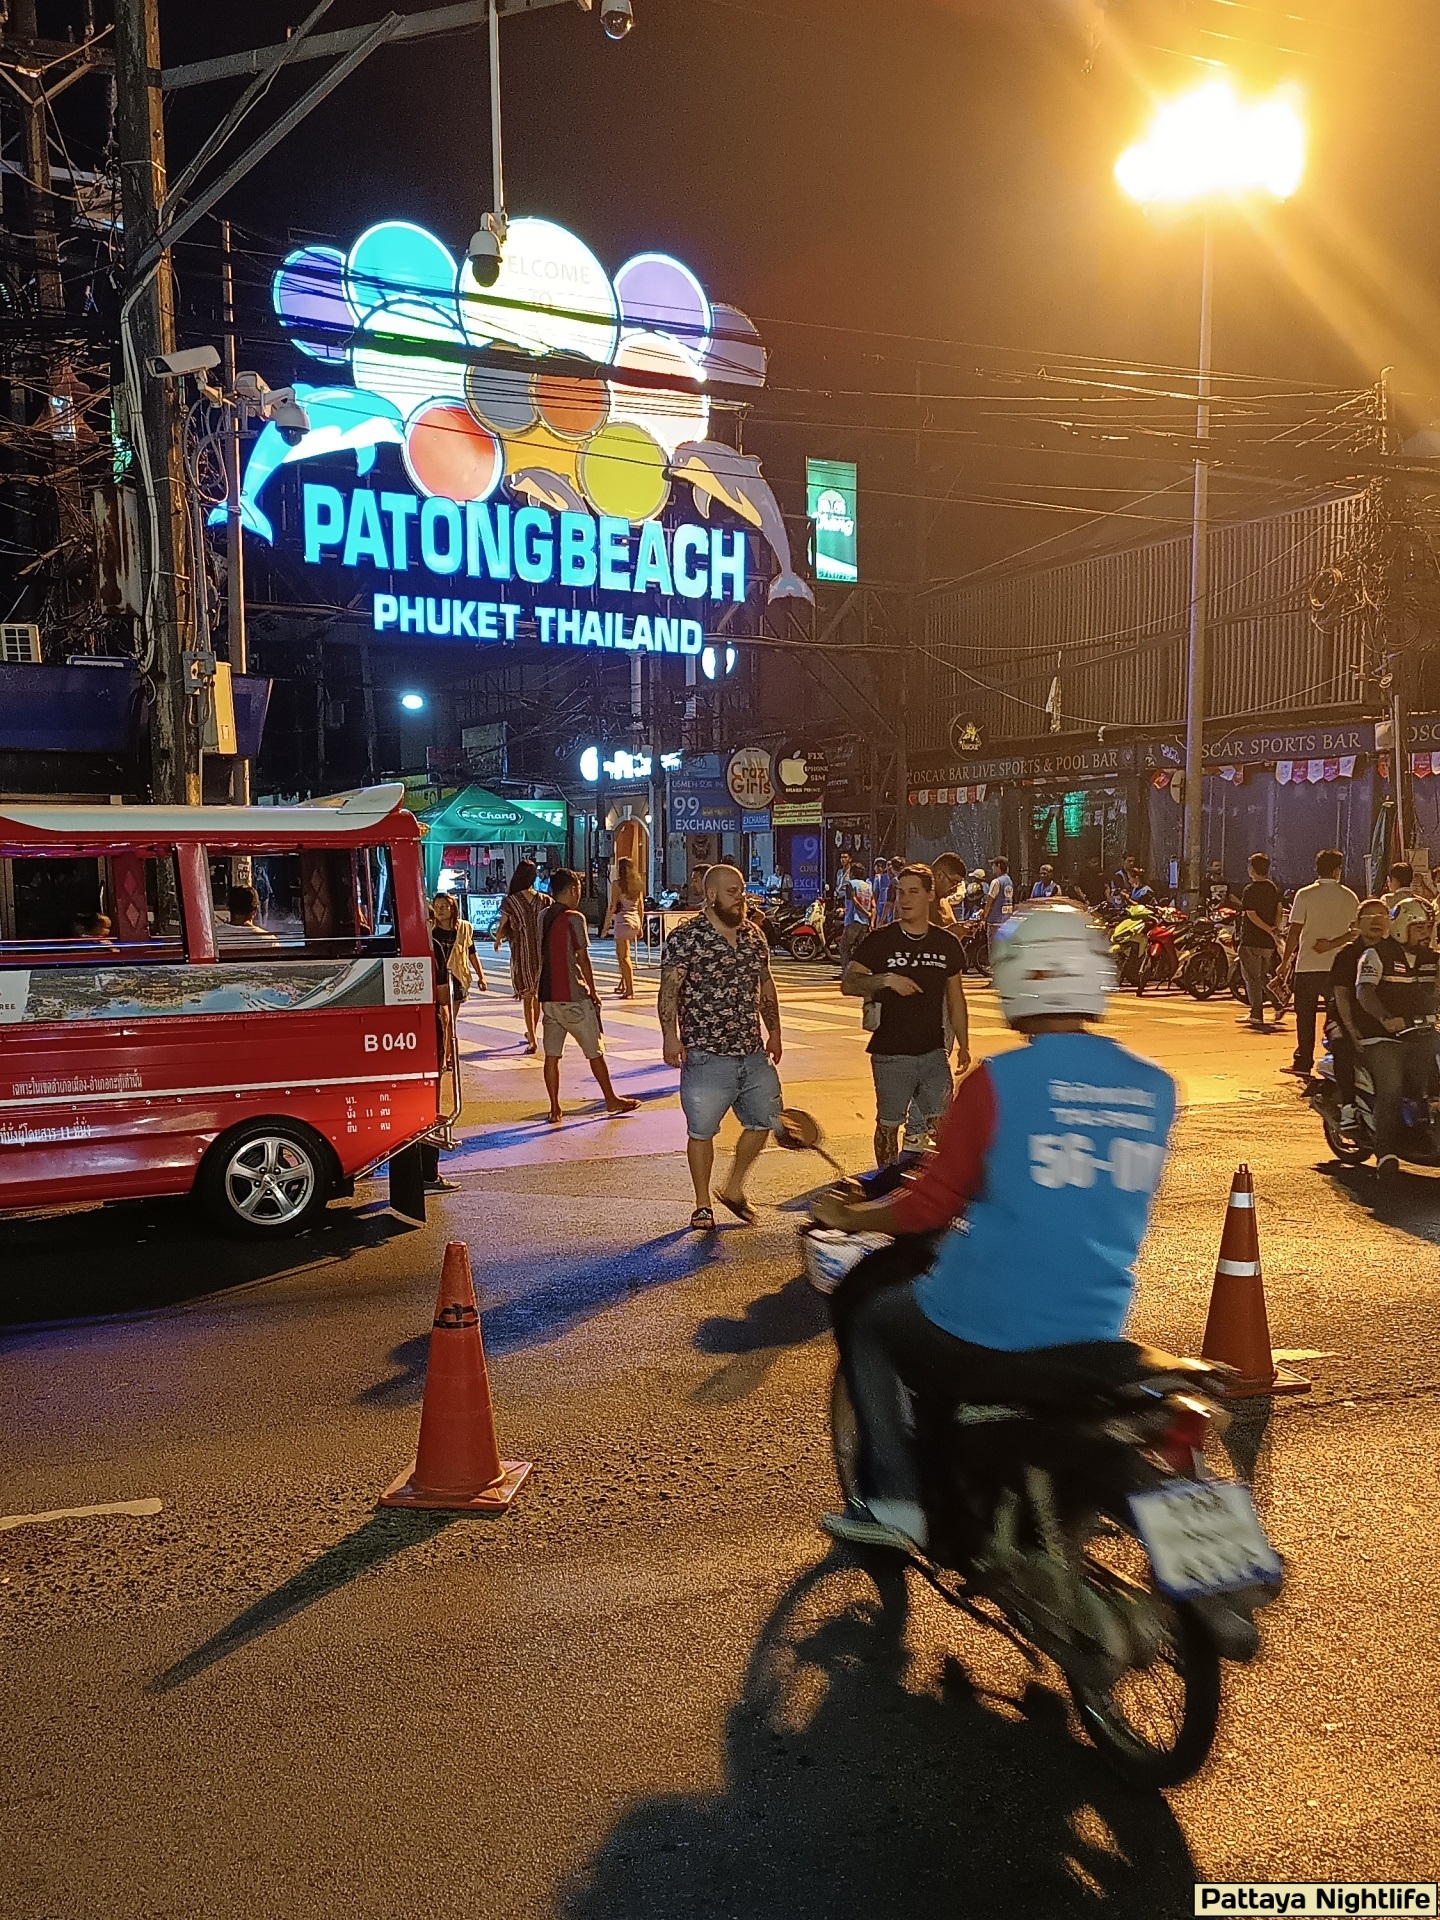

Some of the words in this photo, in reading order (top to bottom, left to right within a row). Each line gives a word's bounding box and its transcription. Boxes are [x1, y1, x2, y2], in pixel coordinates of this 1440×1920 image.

[507, 255, 592, 285] ELCOME
[373, 593, 521, 640] PHUKET
[535, 606, 703, 655] THAILAND
[1201, 739, 1244, 758] SCAR
[1251, 734, 1316, 755] SPORTS
[1322, 732, 1362, 750] BAR
[807, 752, 825, 760] FIX
[731, 761, 770, 778] Crazy
[913, 769, 946, 784] OSCAR
[949, 766, 969, 781] BAR
[972, 763, 995, 779] LIVE
[999, 758, 1040, 776] SPORTS
[1043, 756, 1053, 771] &
[1056, 753, 1089, 770] POOL
[1093, 750, 1118, 768] BAR
[731, 778, 771, 795] Girls
[673, 797, 700, 816] 99
[478, 811, 518, 822] Chang
[675, 819, 736, 831] EXCHANGE
[364, 1034, 379, 1052] B
[382, 1032, 417, 1051] 040
